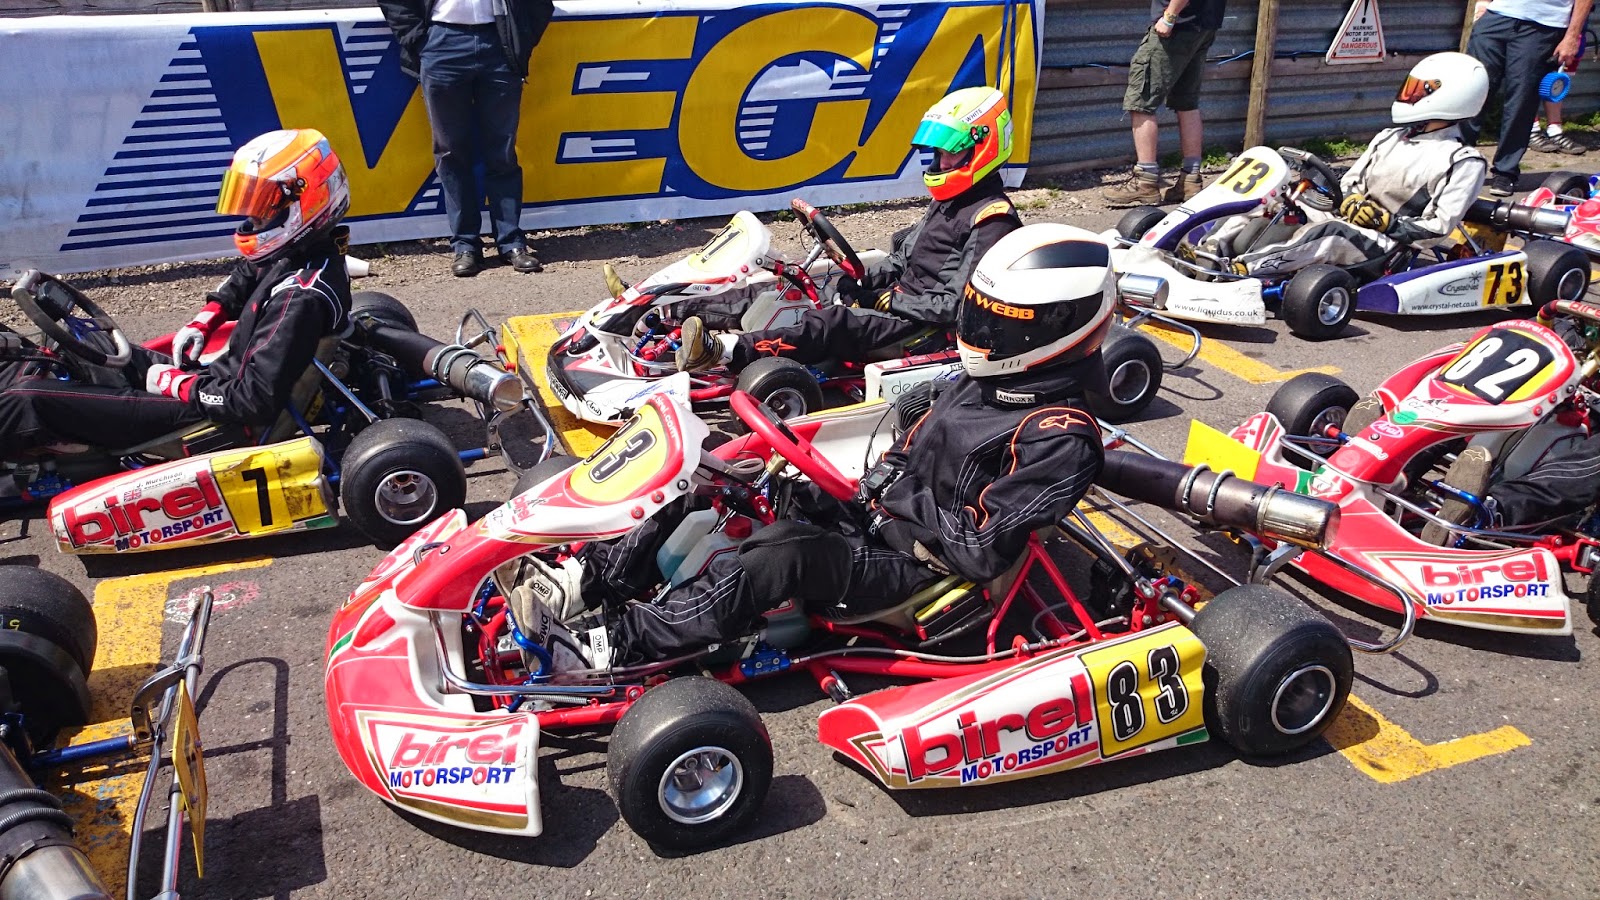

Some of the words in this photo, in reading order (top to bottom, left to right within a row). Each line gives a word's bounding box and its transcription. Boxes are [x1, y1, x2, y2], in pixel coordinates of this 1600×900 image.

[252, 3, 1036, 216] VEGA
[1487, 261, 1523, 305] 73
[976, 293, 1035, 320] WEBB
[1411, 300, 1478, 311] www.crystal-net.co.uk
[1492, 321, 1564, 349] www.birel.com
[1445, 337, 1540, 399] 82
[63, 470, 222, 549] birel
[115, 508, 223, 552] MOTORSPORT
[533, 581, 550, 596] OMP
[1421, 553, 1548, 587] birel
[1427, 583, 1550, 606] MOTORSPORT
[594, 634, 603, 653] OMP
[1107, 644, 1189, 742] 83
[389, 724, 524, 769] birel
[900, 673, 1094, 783] birel
[390, 765, 516, 788] MOTORSPORT
[961, 725, 1093, 784] MOTORSPORT
